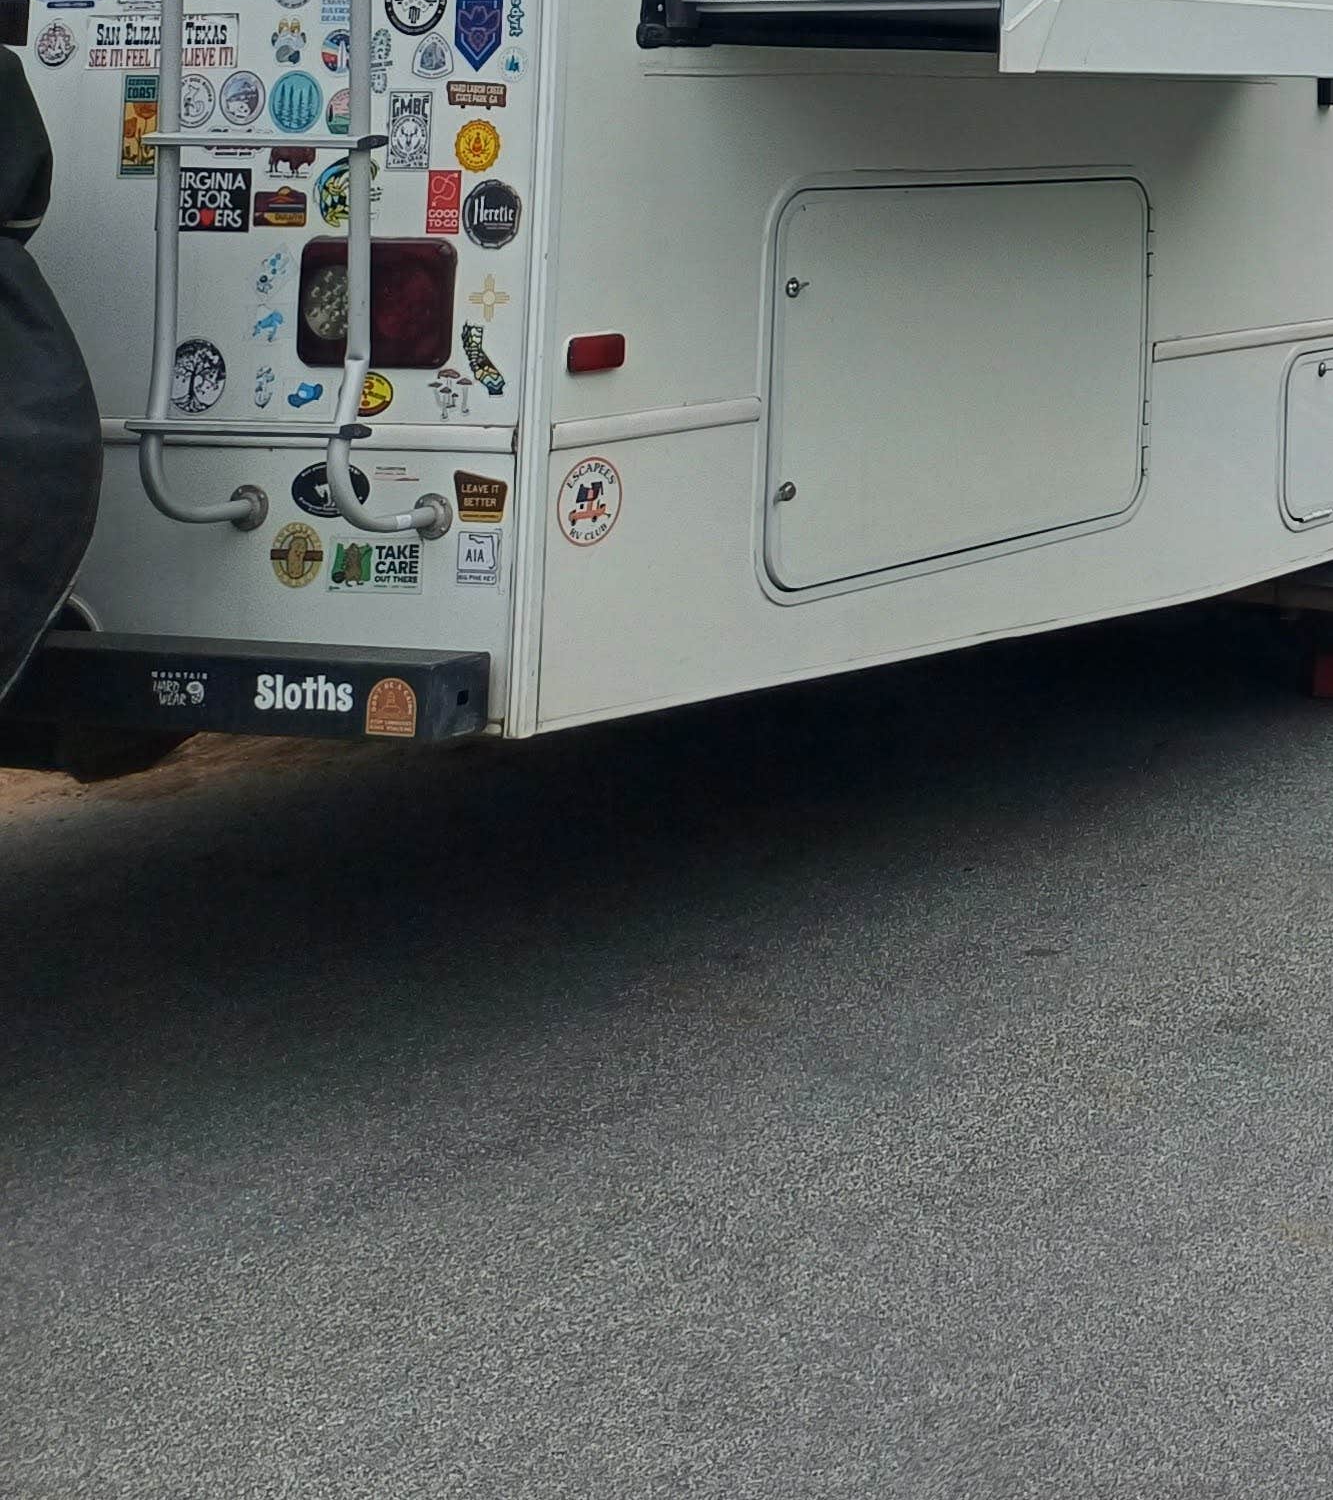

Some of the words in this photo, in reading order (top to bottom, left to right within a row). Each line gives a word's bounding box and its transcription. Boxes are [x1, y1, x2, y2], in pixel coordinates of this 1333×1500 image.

[125, 23, 161, 45] ELIZA
[185, 22, 227, 45] TEXAS
[89, 48, 107, 67] SEE
[110, 48, 123, 67] IT!
[126, 48, 151, 67] FEEL
[182, 48, 216, 67] LIEVE
[218, 47, 234, 66] IT!
[127, 87, 156, 99] COAST
[393, 98, 429, 118] GMBC
[180, 172, 247, 190] IRGINIA
[180, 191, 192, 207] IS
[197, 190, 232, 208] FOR
[428, 209, 459, 218] GOOD
[474, 195, 515, 226] Heretic
[567, 462, 616, 489] ESCAPEES
[461, 483, 489, 493] LEAVE
[491, 484, 500, 493] IT
[463, 497, 497, 507] BETTER
[569, 528, 583, 540] RV
[584, 523, 608, 541] CLUB
[375, 544, 420, 560] TAKE
[375, 560, 419, 574] CARE
[375, 575, 391, 583] OUT
[393, 575, 418, 583] THERE
[151, 671, 208, 680] MOUNTAIN
[254, 673, 354, 713] Sloths
